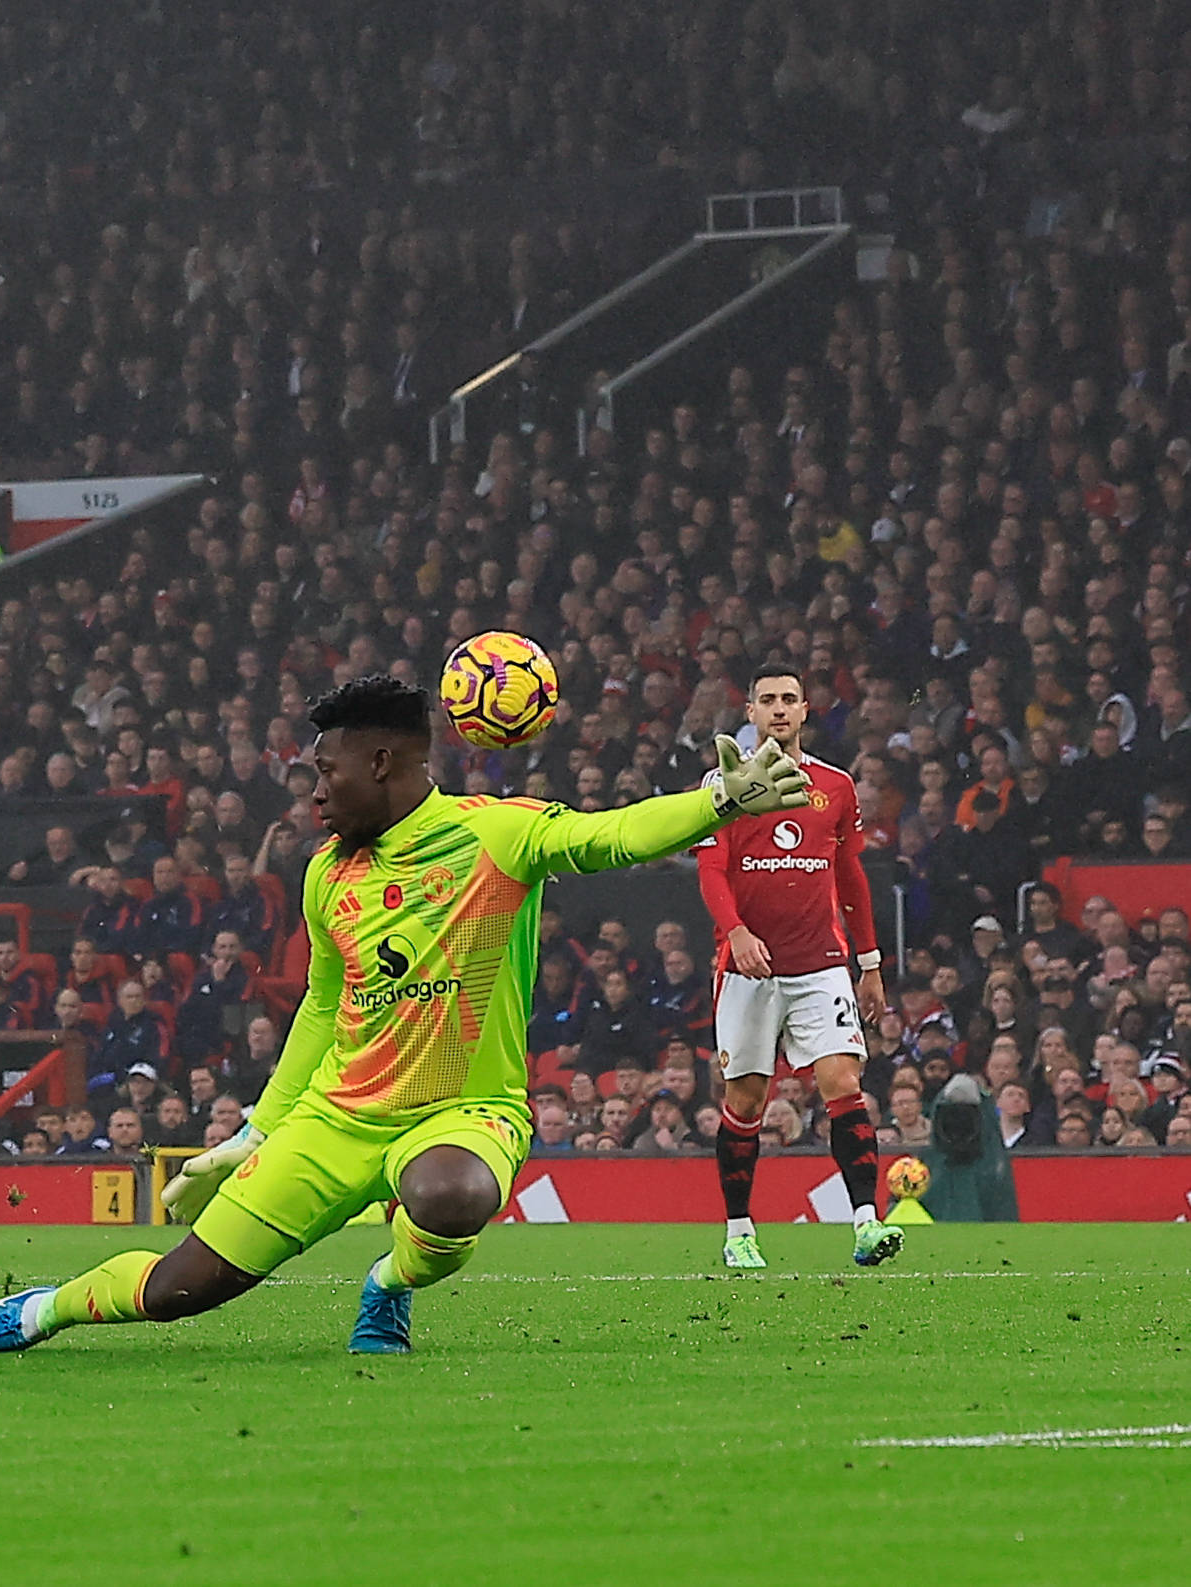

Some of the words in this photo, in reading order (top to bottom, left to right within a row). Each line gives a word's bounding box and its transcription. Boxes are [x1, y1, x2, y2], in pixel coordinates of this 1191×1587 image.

[741, 854, 829, 873] Snapdragon
[833, 996, 860, 1028] 2
[108, 1191, 120, 1217] 4
